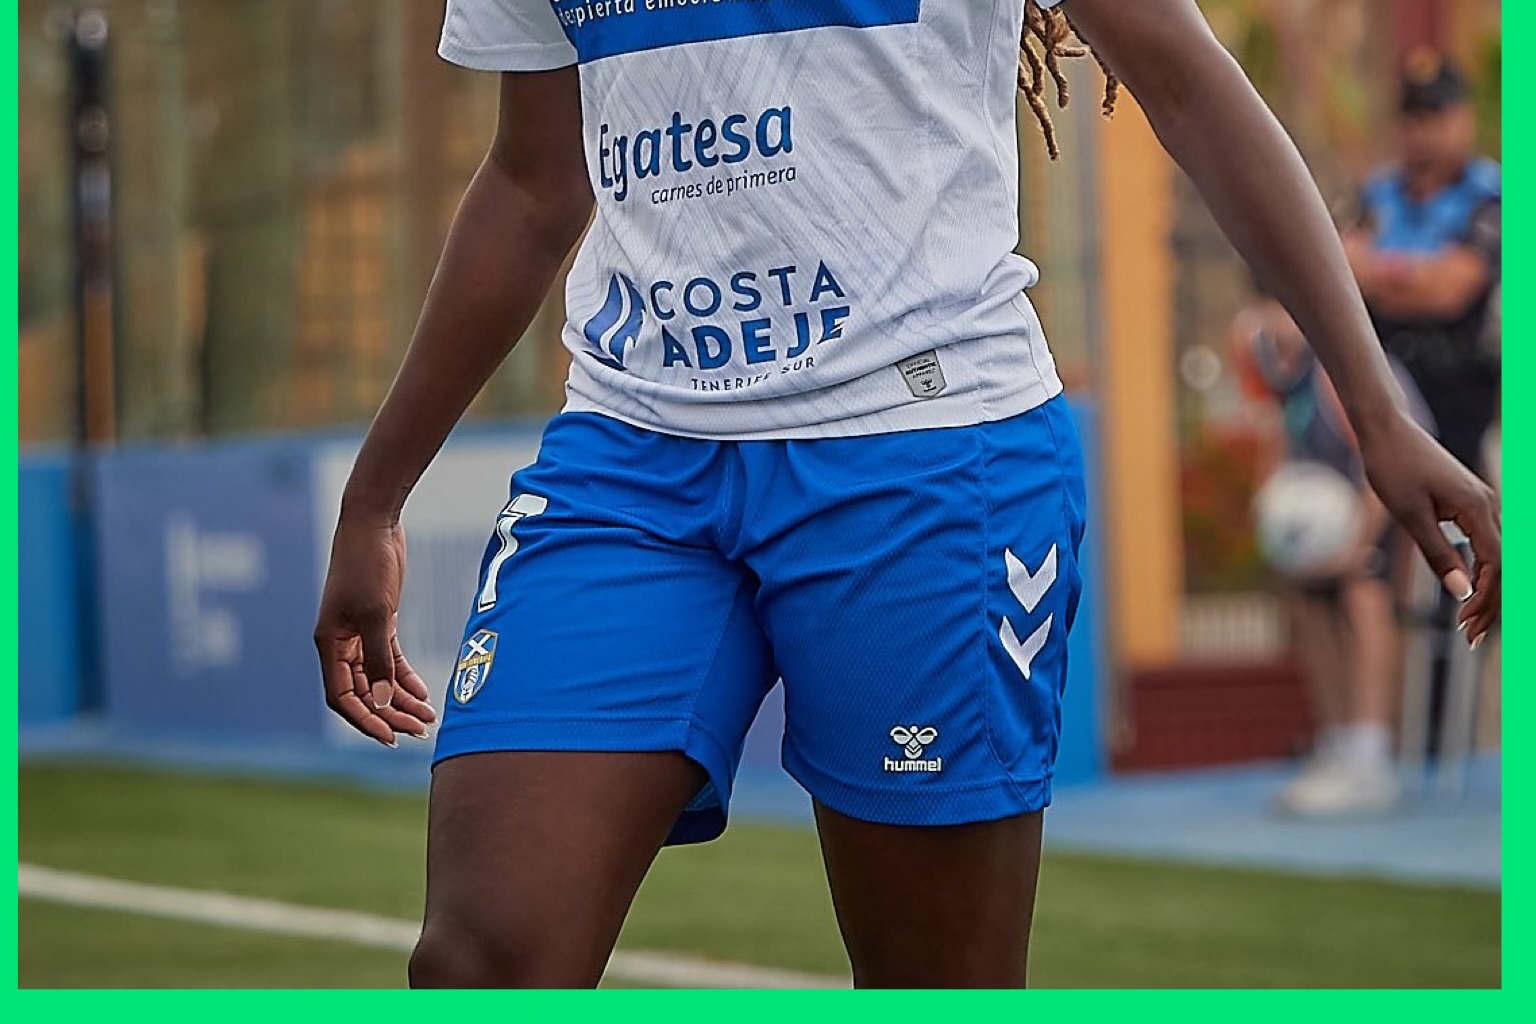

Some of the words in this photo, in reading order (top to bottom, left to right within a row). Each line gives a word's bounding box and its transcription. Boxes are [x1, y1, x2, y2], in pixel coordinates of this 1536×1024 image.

[599, 106, 794, 202] Egatesa
[651, 182, 702, 205] carnes
[706, 175, 724, 195] de
[727, 166, 797, 197] primera
[650, 259, 845, 321] COSTA
[663, 306, 850, 371] ADEJE
[781, 357, 814, 374] SUR
[884, 756, 942, 772] hummel
